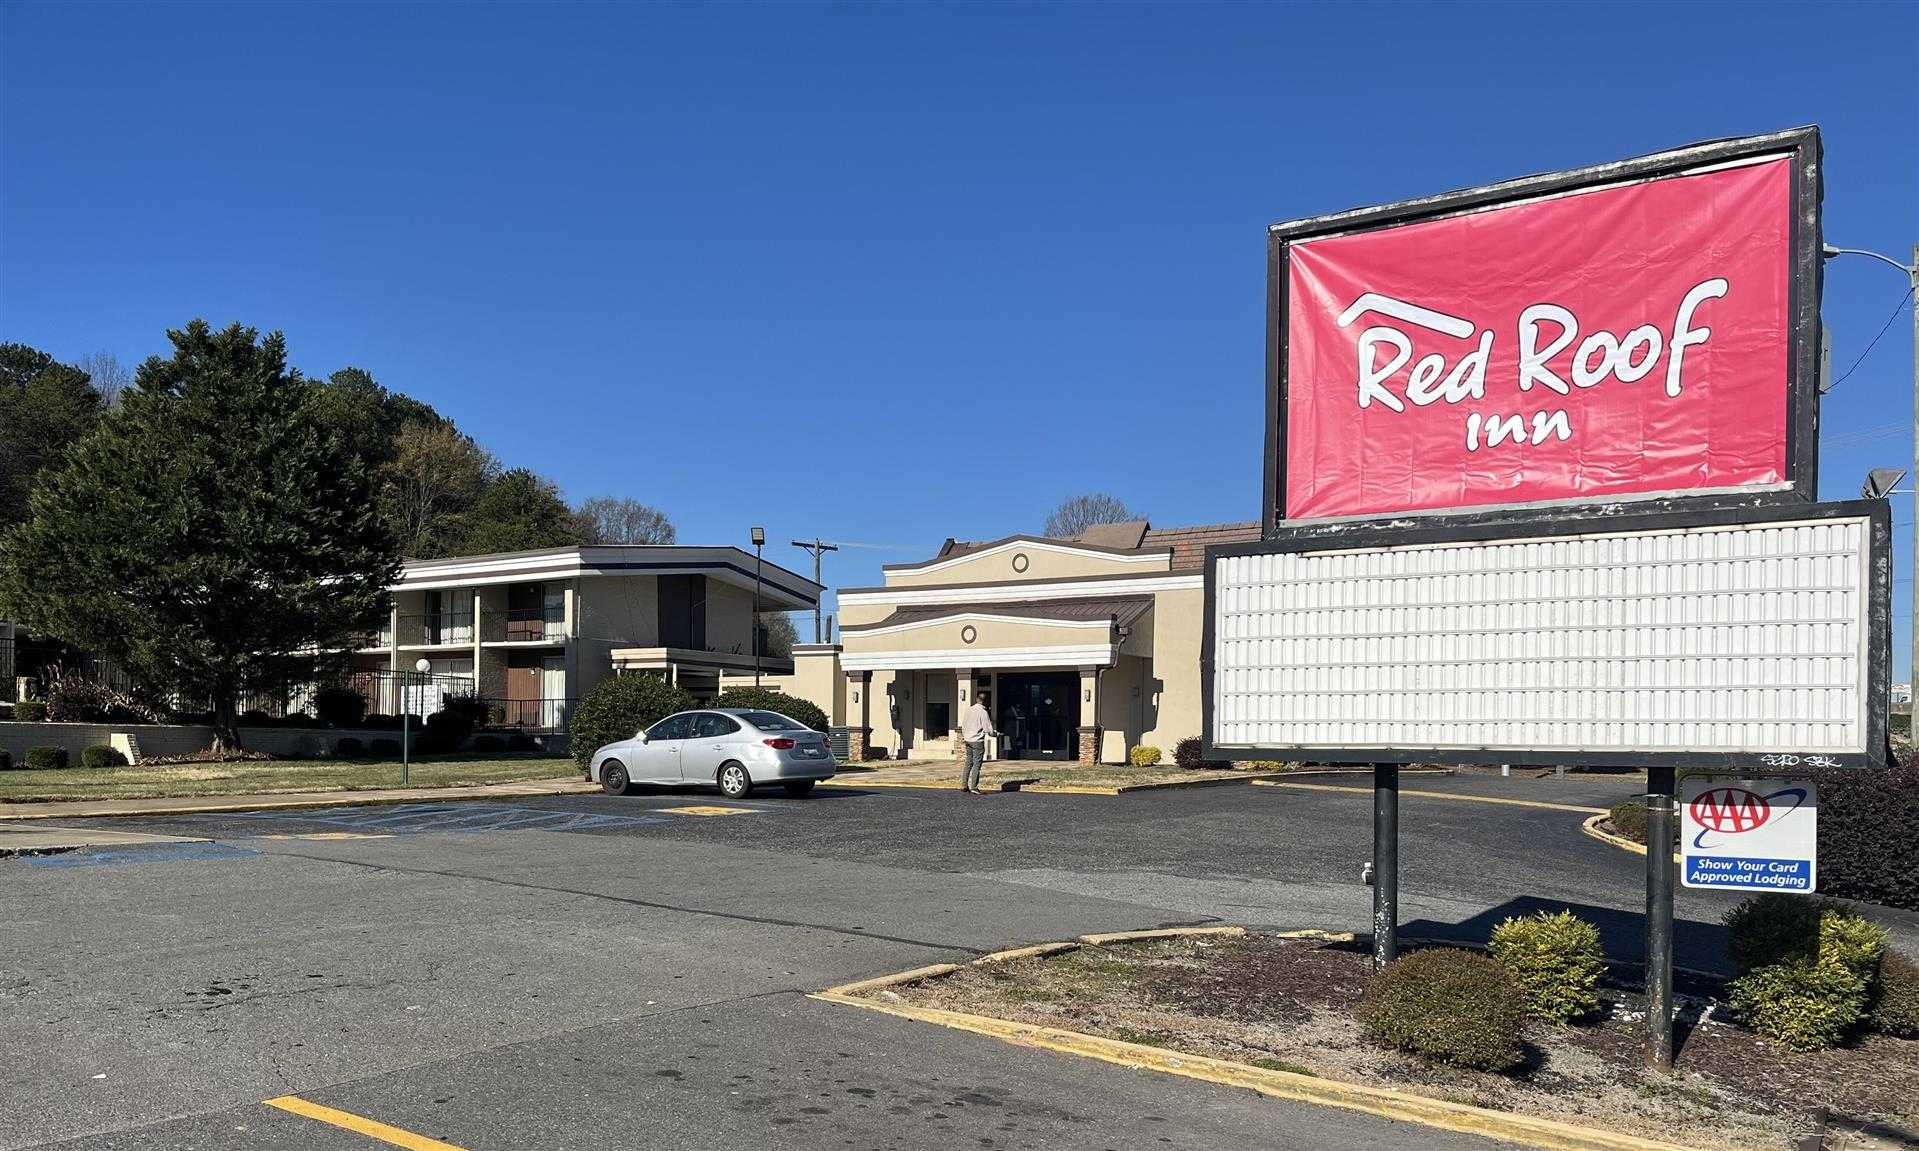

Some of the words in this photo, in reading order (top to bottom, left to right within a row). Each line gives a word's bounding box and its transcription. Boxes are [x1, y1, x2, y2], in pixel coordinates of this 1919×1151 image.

[1363, 324, 1495, 413] Red
[1518, 277, 1729, 397] Roof
[1697, 788, 1762, 832] AAA
[1691, 870, 1752, 883] Approved
[1754, 872, 1806, 887] Lodging
[1698, 859, 1732, 870] Show
[1737, 860, 1766, 872] Your
[1769, 862, 1799, 873] Card
